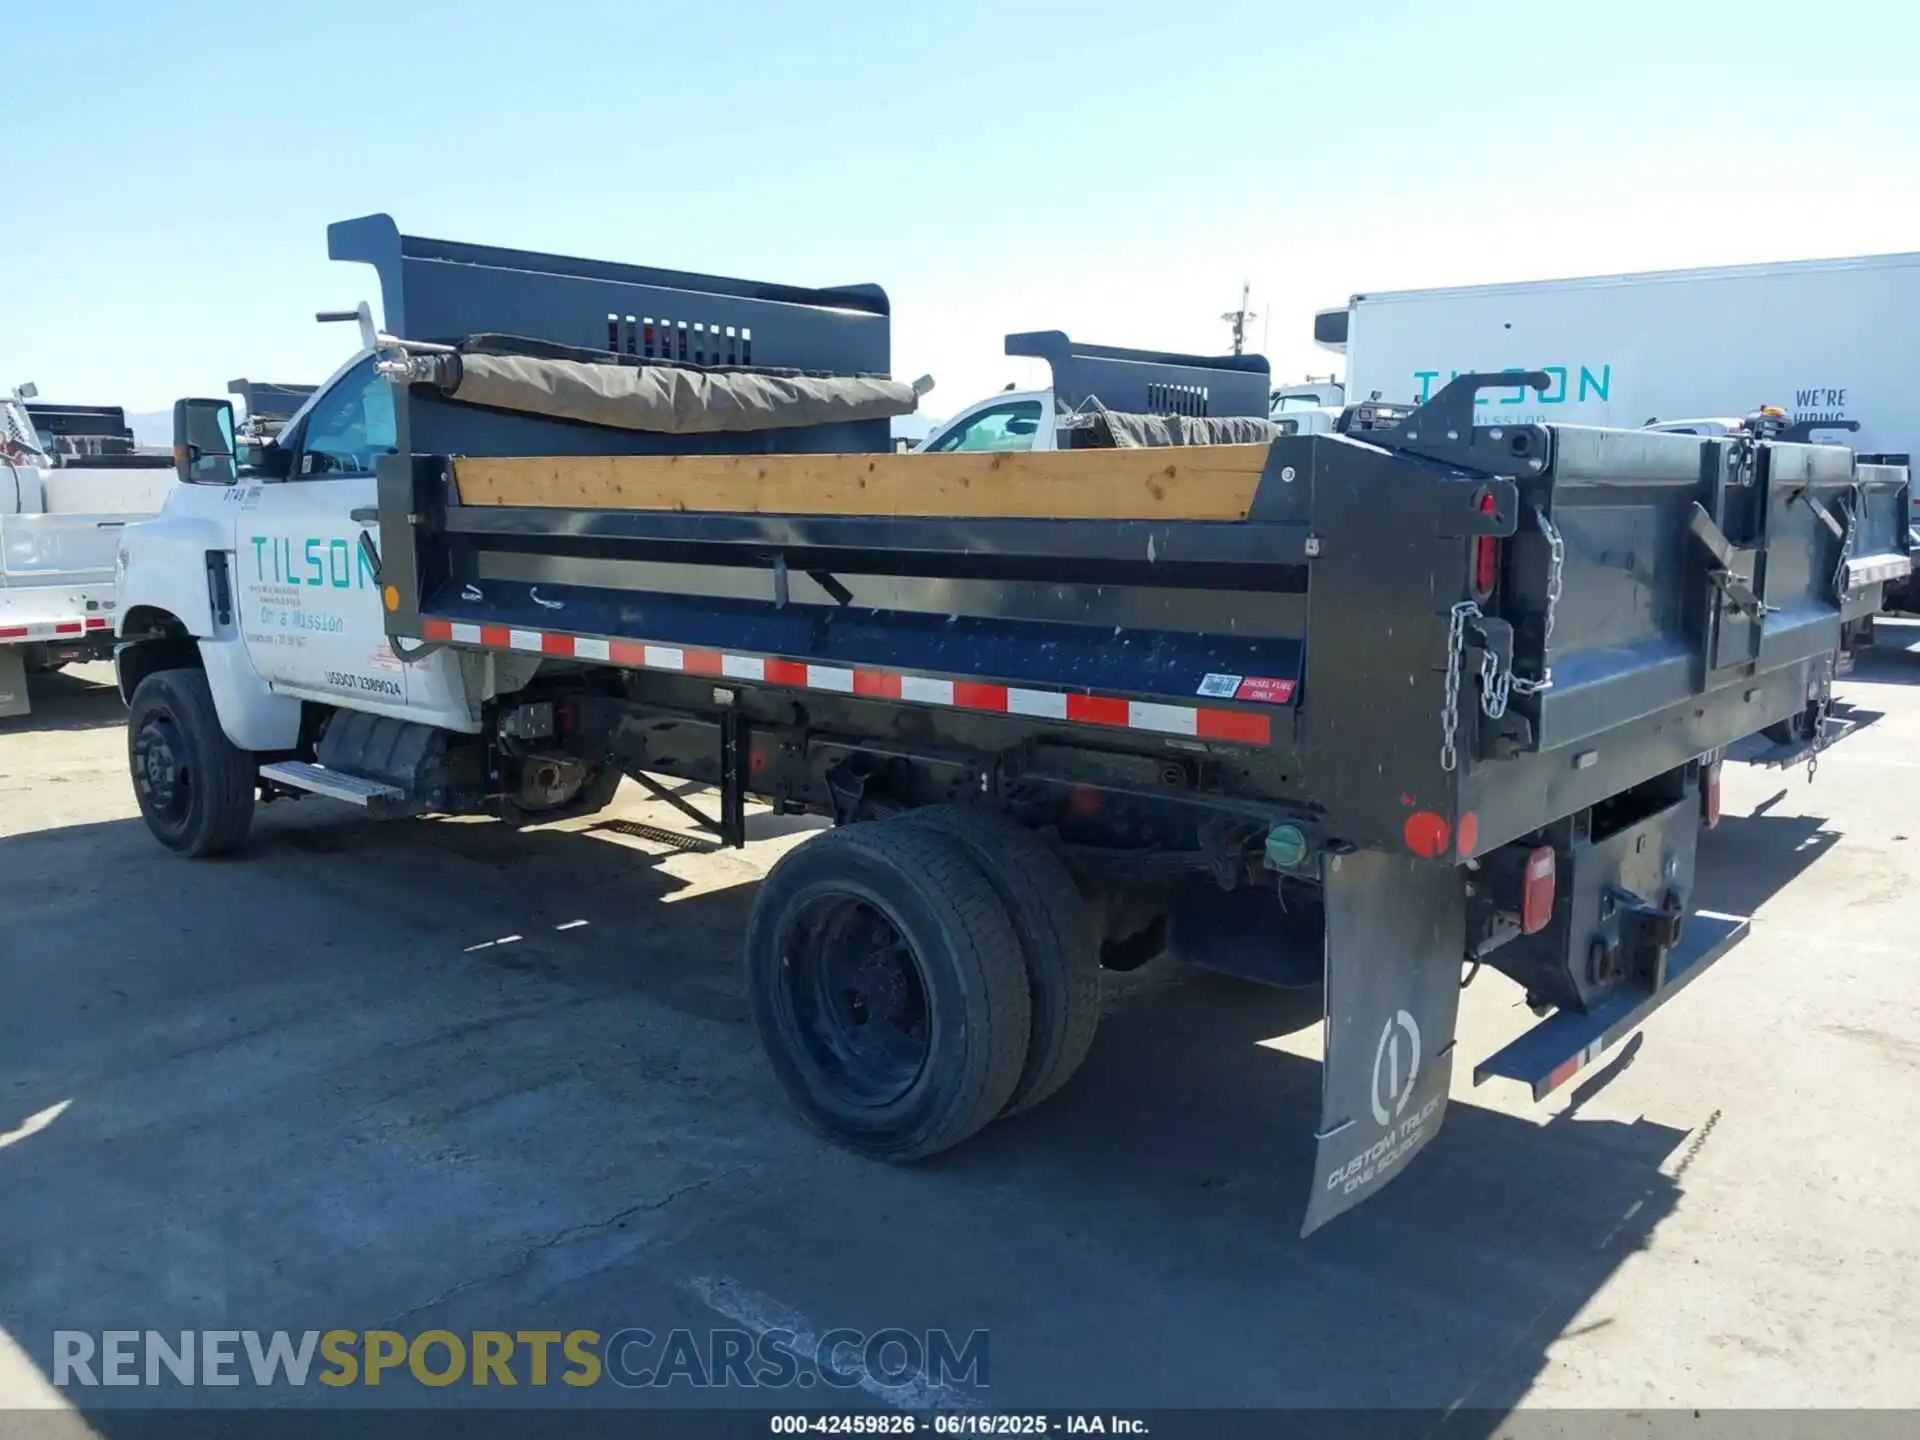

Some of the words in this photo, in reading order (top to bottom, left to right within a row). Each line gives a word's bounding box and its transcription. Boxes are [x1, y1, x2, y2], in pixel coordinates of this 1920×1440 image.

[1413, 364, 1611, 404] TSON
[1796, 388, 1847, 407] WE'RE
[251, 536, 380, 590] TILSON
[292, 608, 344, 633] Mission
[1327, 1130, 1396, 1191] CUSTOM
[1400, 1092, 1441, 1137] TRUCK
[1343, 1165, 1375, 1195] ONE
